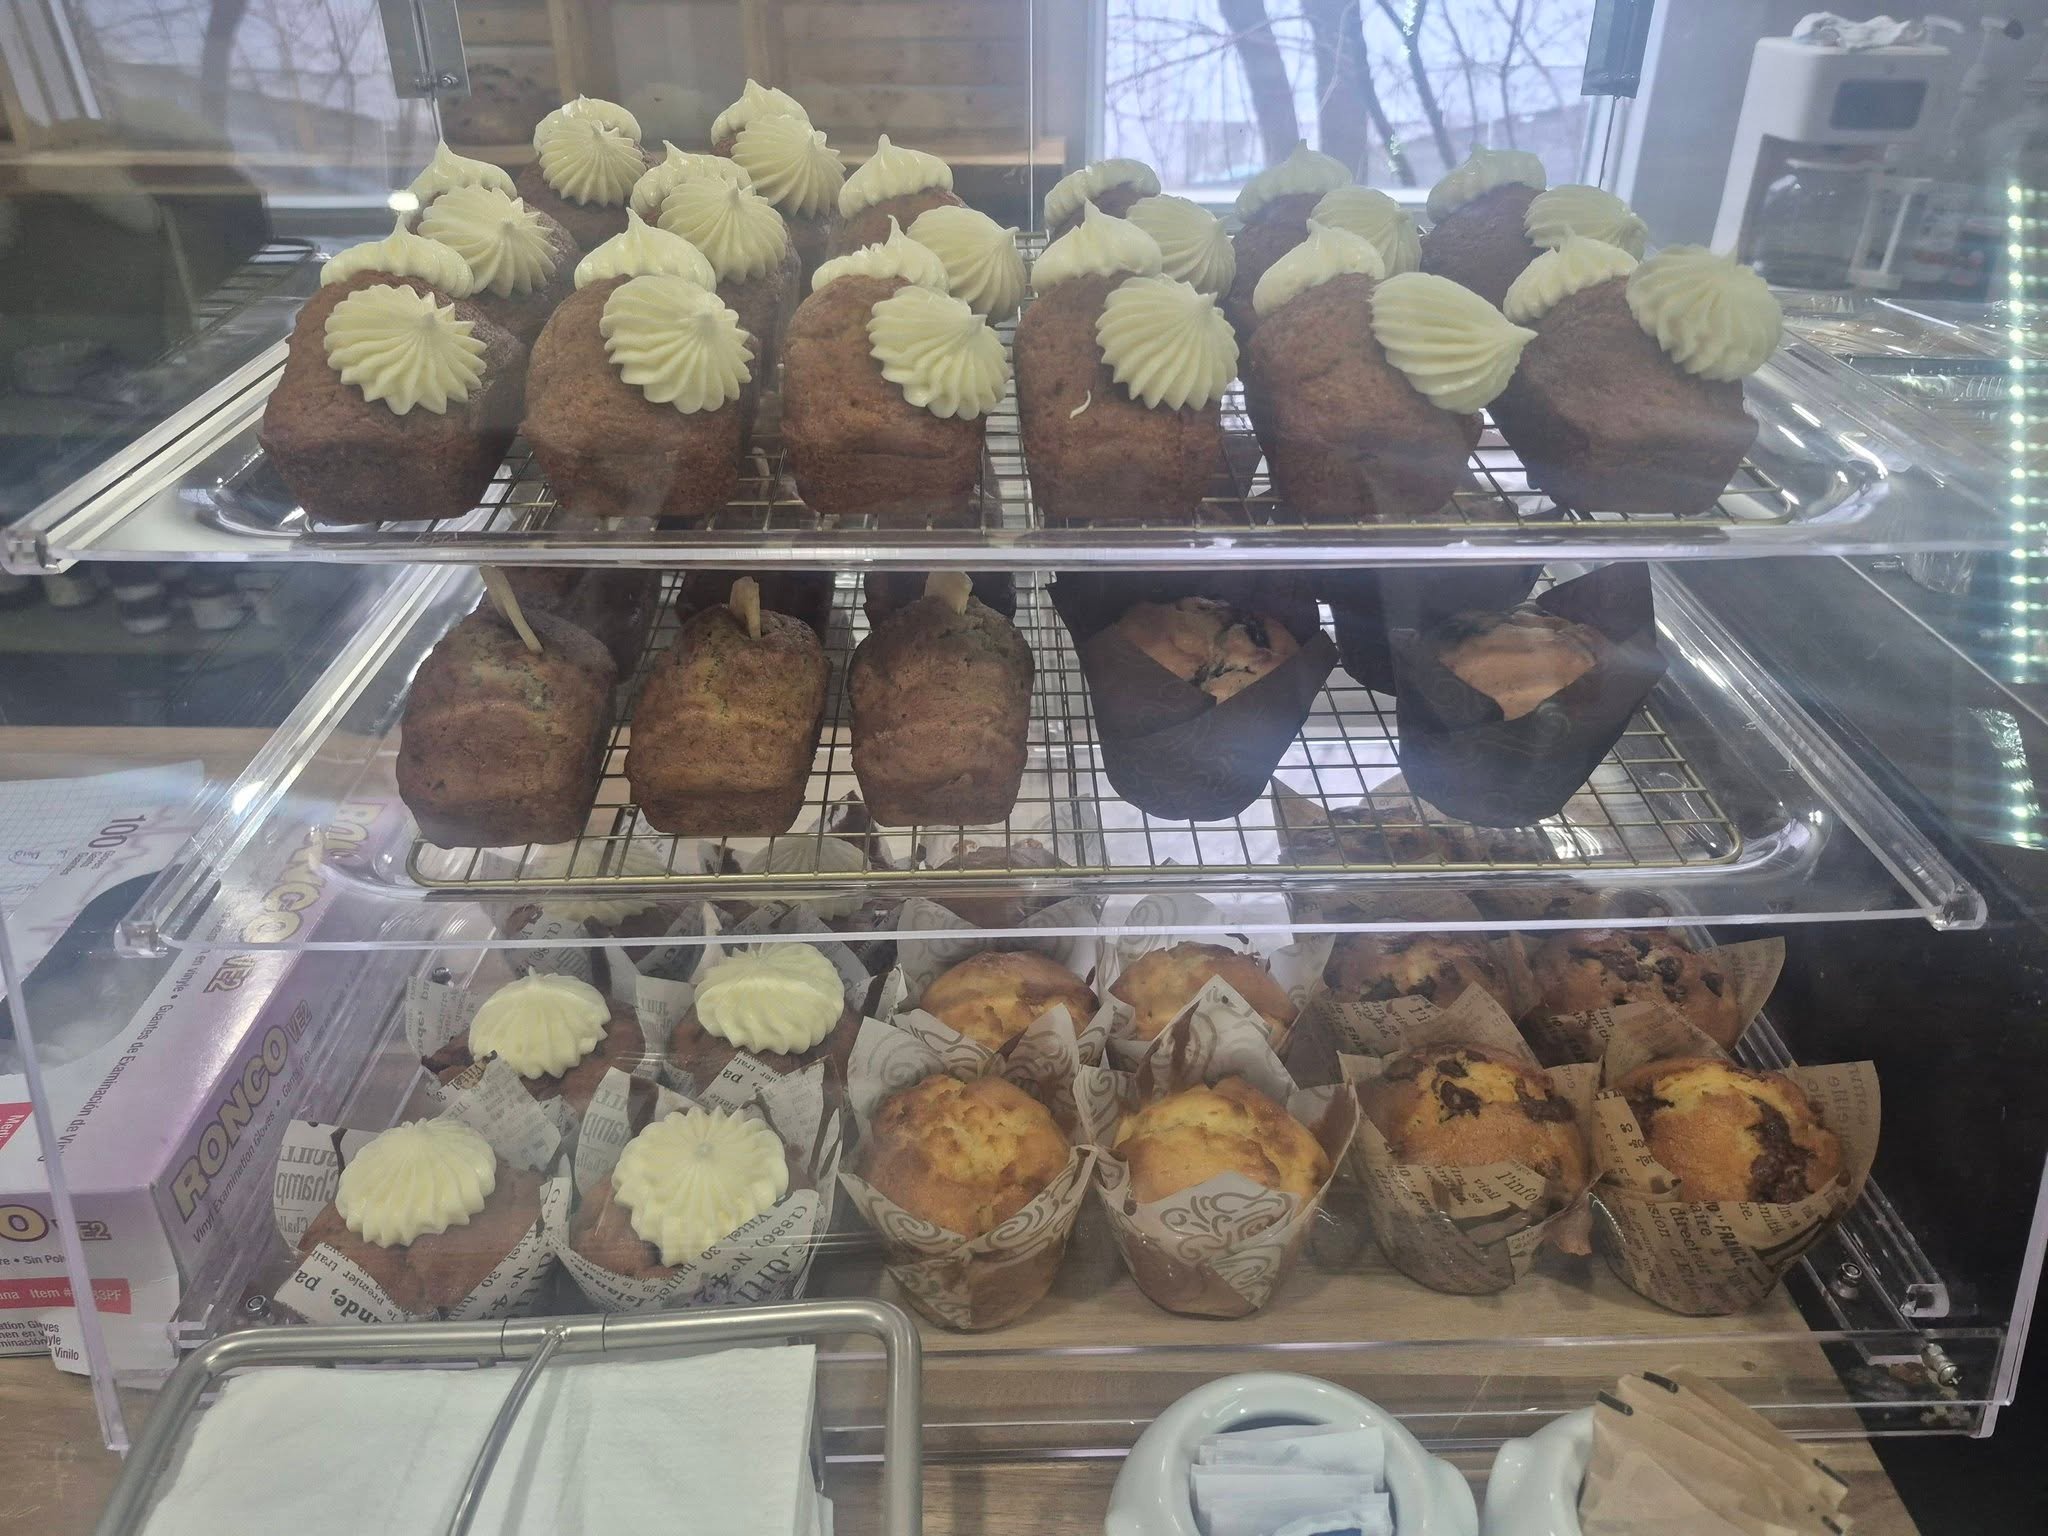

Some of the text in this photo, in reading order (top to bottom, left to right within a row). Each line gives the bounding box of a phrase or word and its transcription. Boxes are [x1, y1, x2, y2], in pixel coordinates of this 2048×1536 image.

[88, 814, 147, 848] 100
[137, 1003, 174, 1041] Guantes
[125, 1041, 145, 1054] de
[76, 1054, 136, 1117] Examinación
[65, 1118, 87, 1133] de
[170, 1024, 289, 1225] RONCO
[284, 999, 313, 1044] VE2
[193, 1207, 216, 1245] Vinyl
[211, 1146, 255, 1214] Examination
[23, 1254, 43, 1265] Sin
[30, 1287, 61, 1299] Item
[341, 1271, 386, 1307] premier
[54, 1347, 80, 1361] Vinilo
